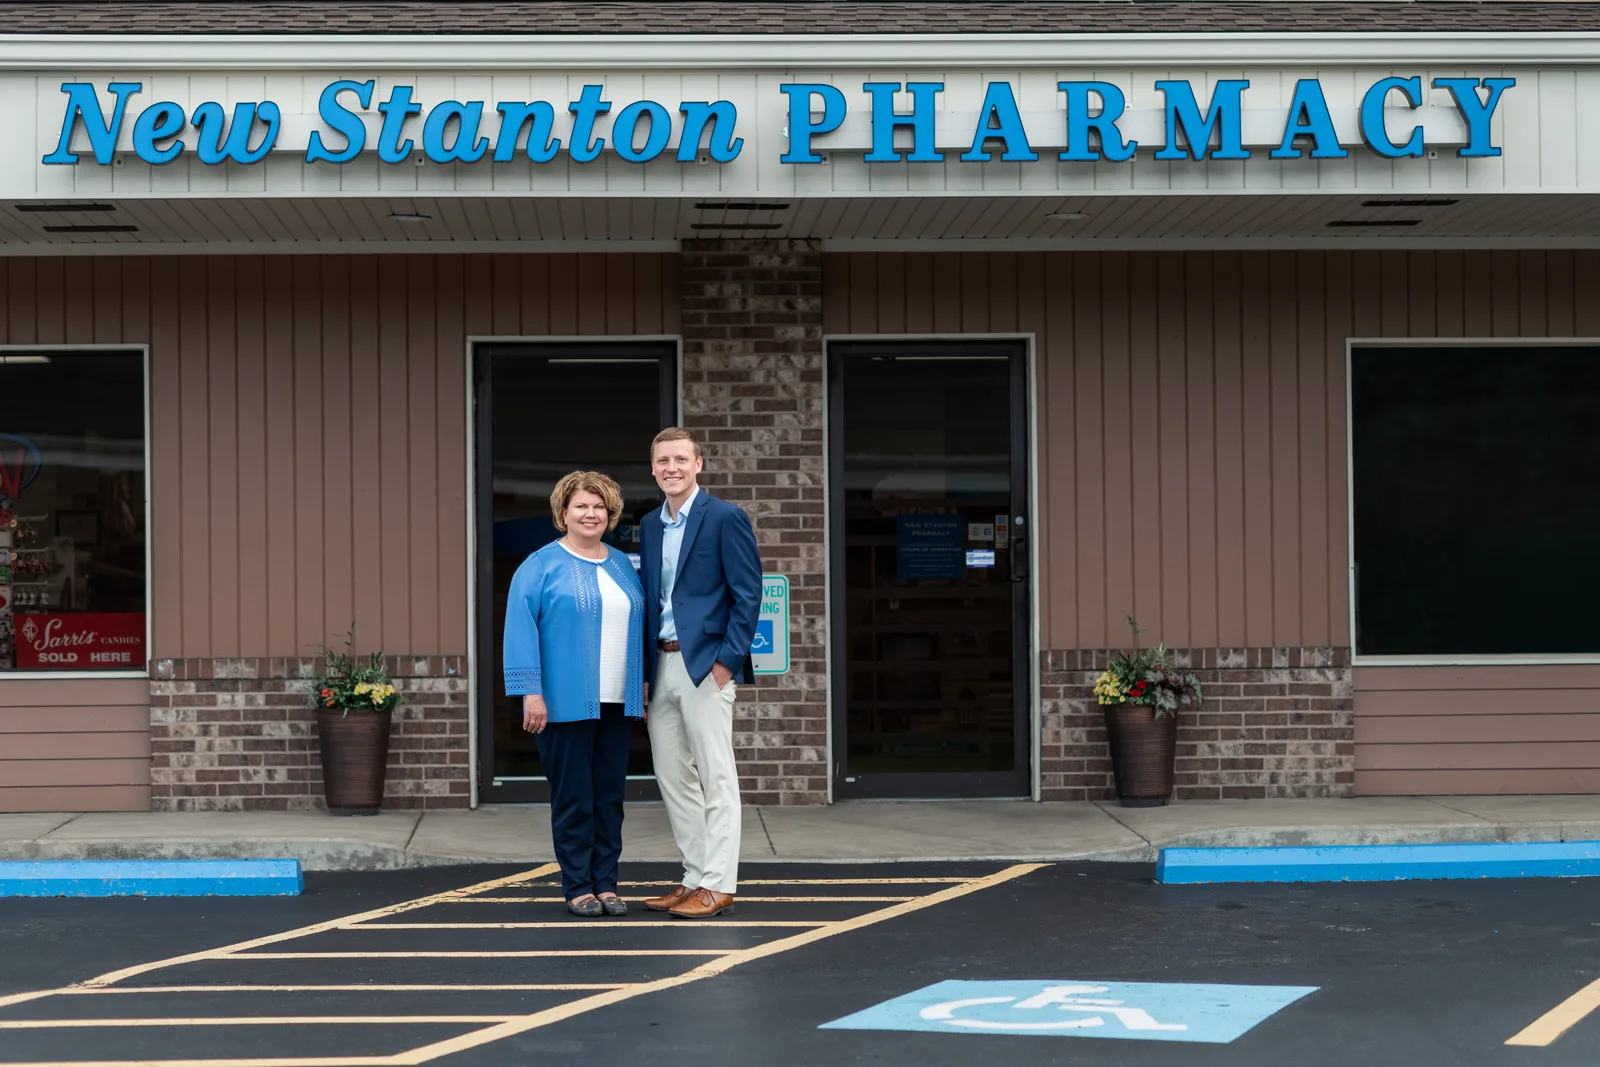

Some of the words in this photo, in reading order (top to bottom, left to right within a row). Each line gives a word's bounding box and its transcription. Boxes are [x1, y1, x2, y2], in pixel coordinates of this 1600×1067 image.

[42, 82, 280, 165] New
[305, 79, 743, 164] Stanton
[780, 76, 1516, 164] PHARMACY
[34, 618, 97, 651] Sarris
[100, 636, 141, 645] CANDIES
[38, 652, 78, 663] SOLD
[90, 652, 131, 663] HERE
